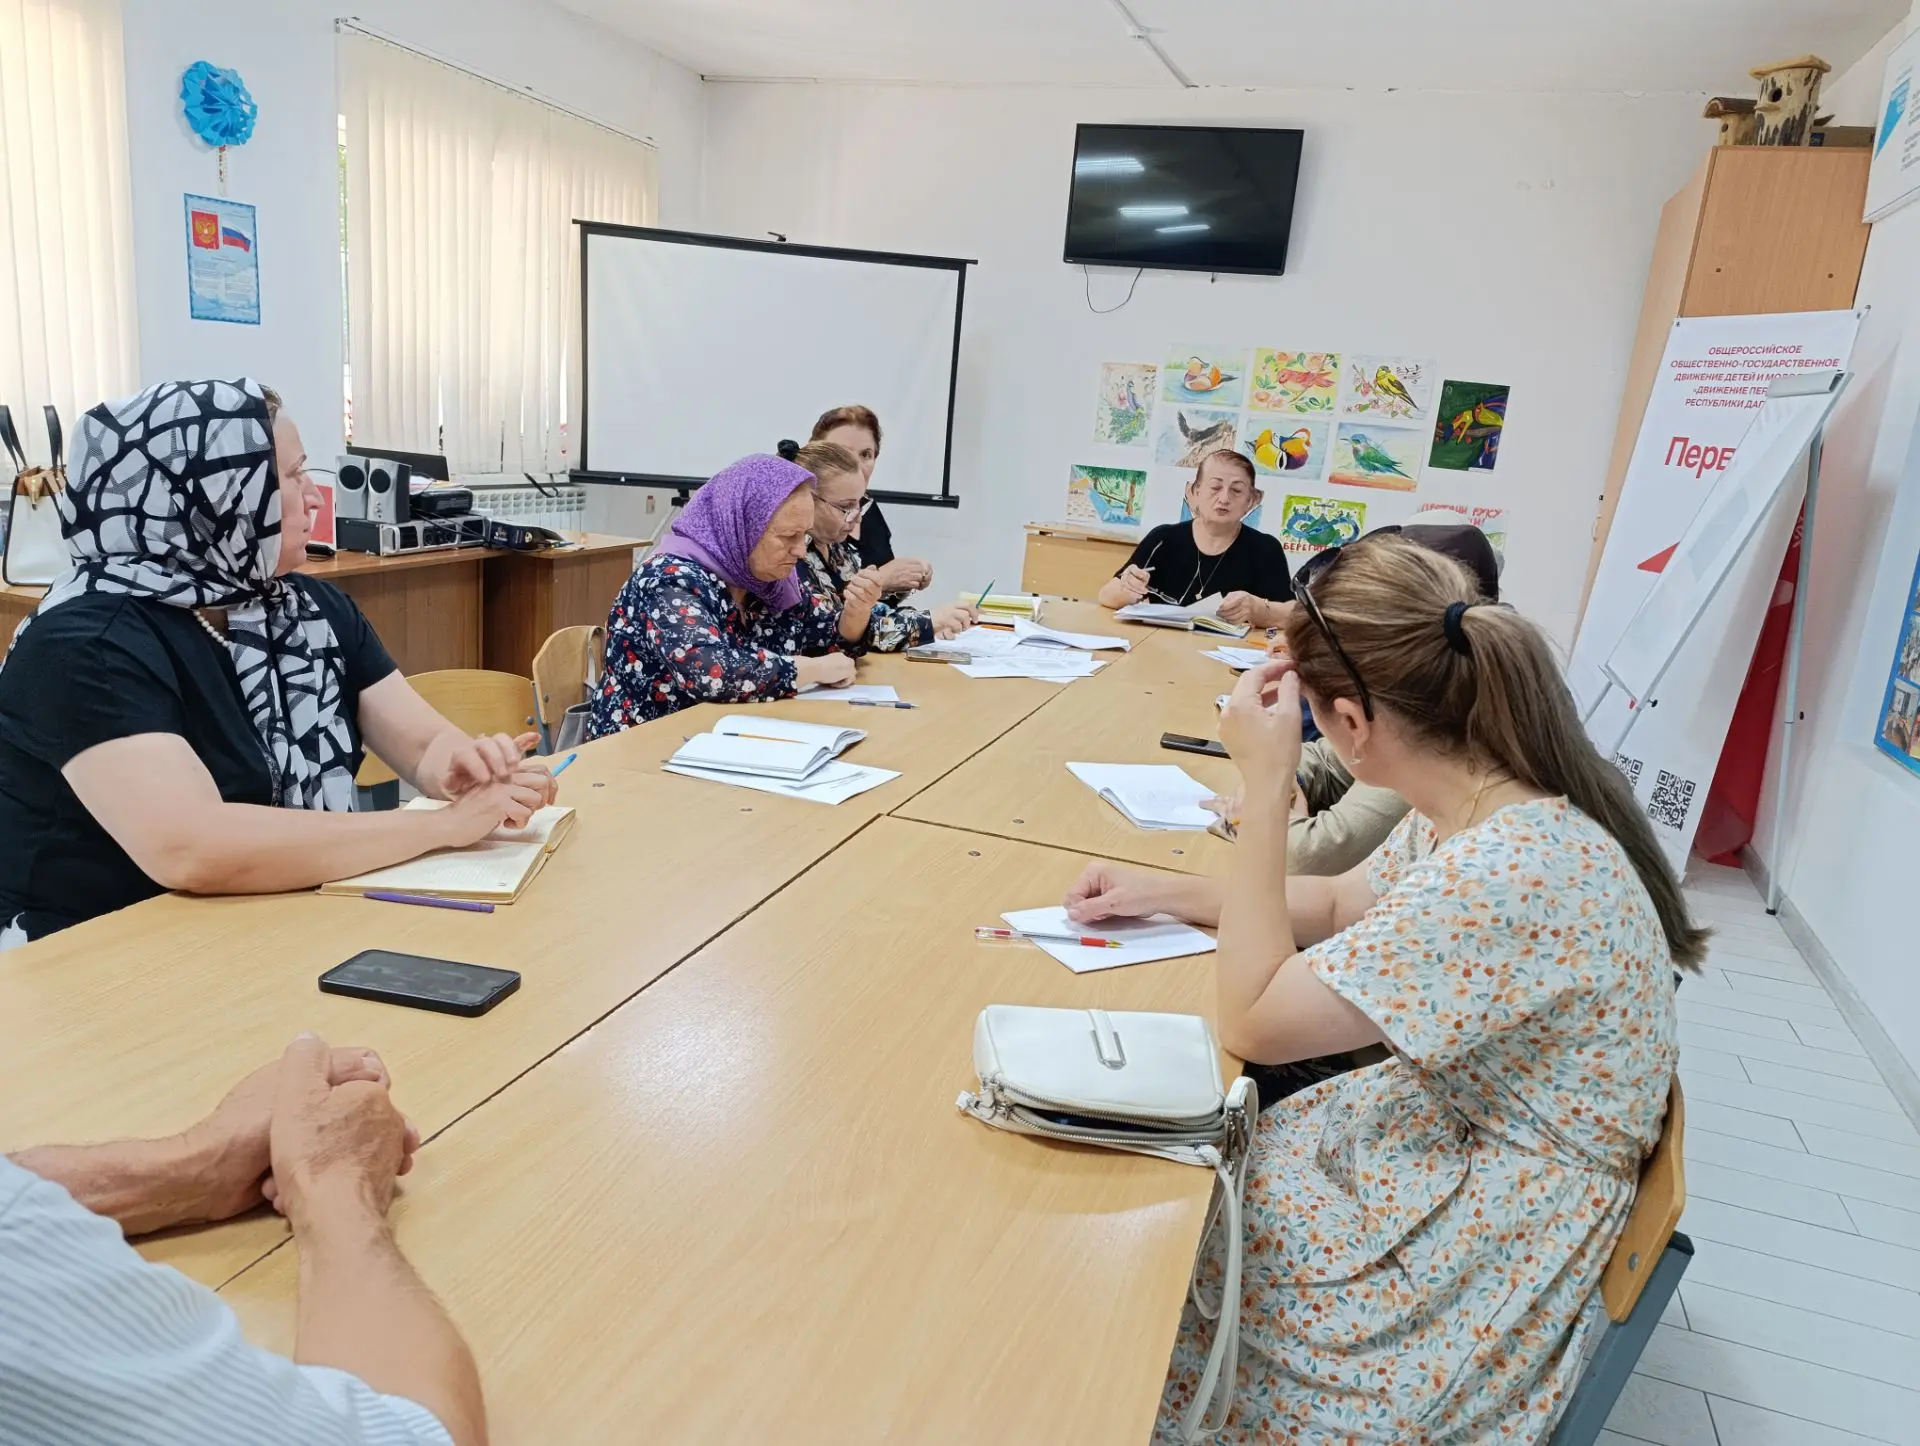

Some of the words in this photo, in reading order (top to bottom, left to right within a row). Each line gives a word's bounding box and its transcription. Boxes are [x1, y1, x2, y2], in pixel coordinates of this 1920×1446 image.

[1708, 344, 1803, 355] ОБЩЕРОССИЙСКОЕ
[1670, 358, 1840, 368] ОБЩЕСТВЕННО-ГОСУДАРСТВЕННОЕ
[1674, 373, 1723, 382] ДВИЖЕНИЕ
[1724, 371, 1756, 382] ДЕТЕЙ
[1756, 373, 1765, 381] И
[1685, 398, 1744, 408] РЕСПУБЛИКИ
